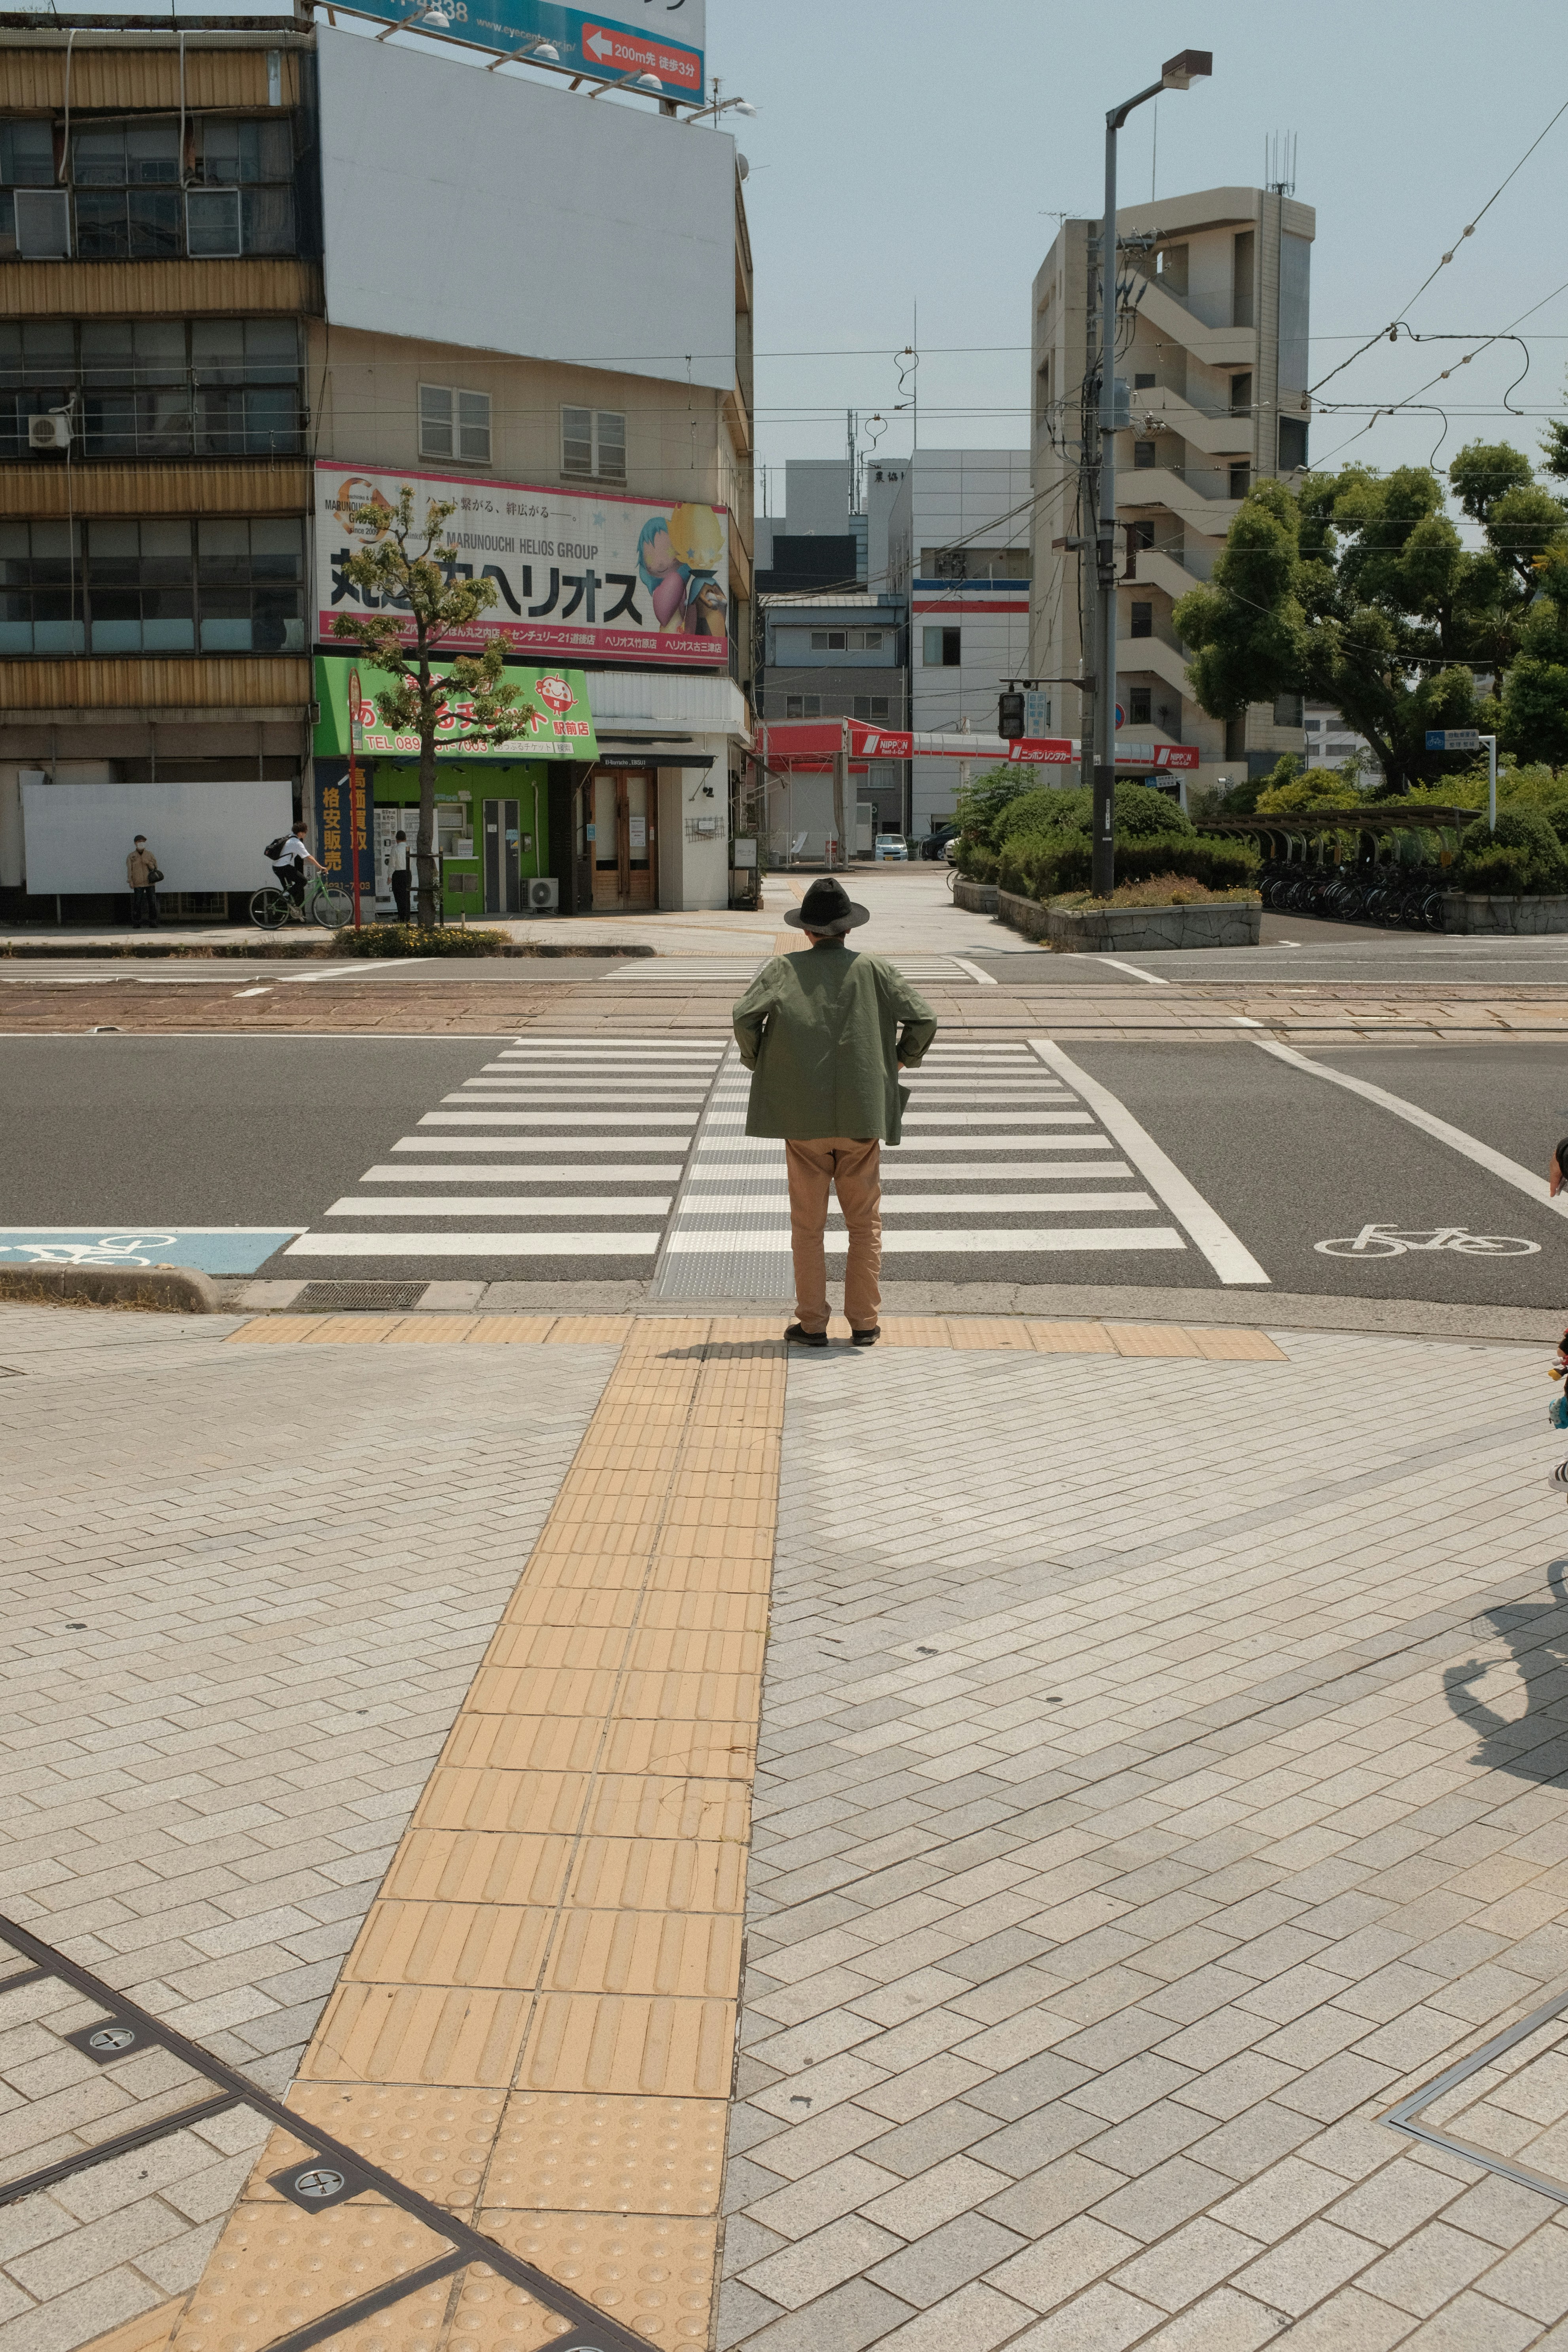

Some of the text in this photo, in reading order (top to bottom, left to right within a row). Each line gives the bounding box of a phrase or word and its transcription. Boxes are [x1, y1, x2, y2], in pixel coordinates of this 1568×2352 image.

[615, 44, 695, 77] 200m先 徒歩3分
[447, 532, 598, 560] MARUNOUCHI HELIOS GROUP
[512, 630, 595, 645] センチュリー21道後店
[605, 637, 656, 649] ヘリオス竹原店
[554, 722, 589, 735] 駅前店
[366, 737, 393, 749] TEL
[880, 740, 908, 750] NIPPON
[1021, 751, 1071, 761] ニッポンレンタカー
[1170, 753, 1192, 761] NIPPON
[323, 787, 342, 870] 格安販売
